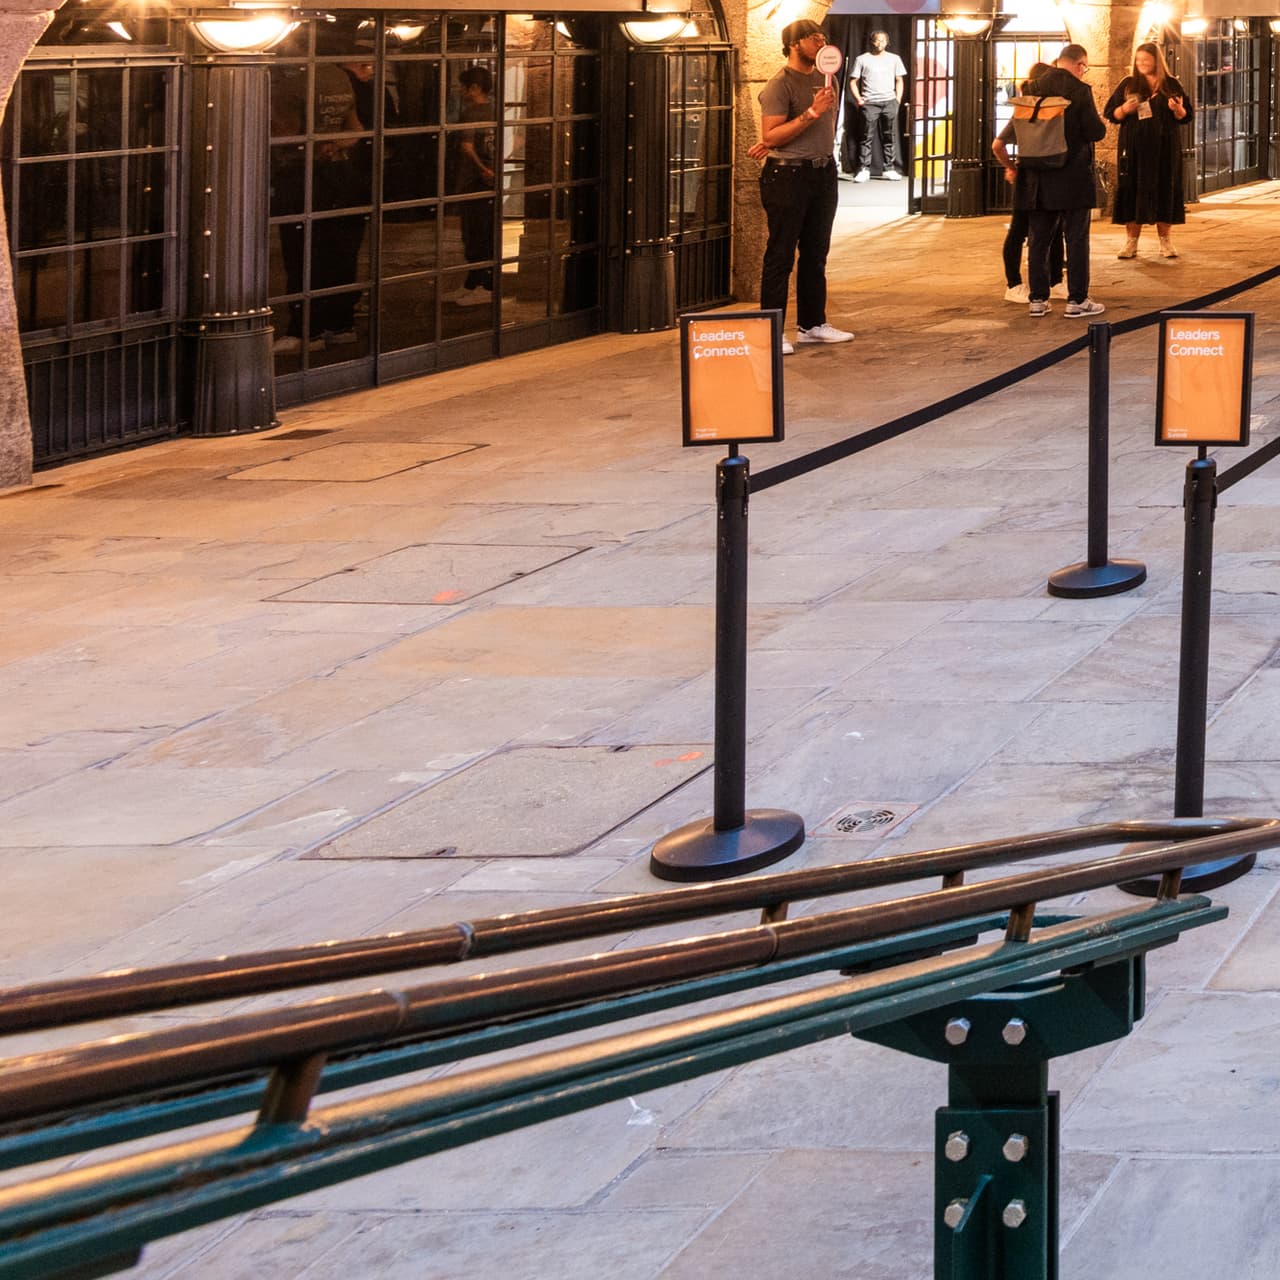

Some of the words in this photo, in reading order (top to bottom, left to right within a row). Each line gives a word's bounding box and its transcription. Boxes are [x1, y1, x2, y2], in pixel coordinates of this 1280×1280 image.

[692, 330, 745, 342] Leaders
[1169, 327, 1220, 340] Leaders
[693, 345, 751, 358] Connect
[1168, 343, 1224, 356] Connect
